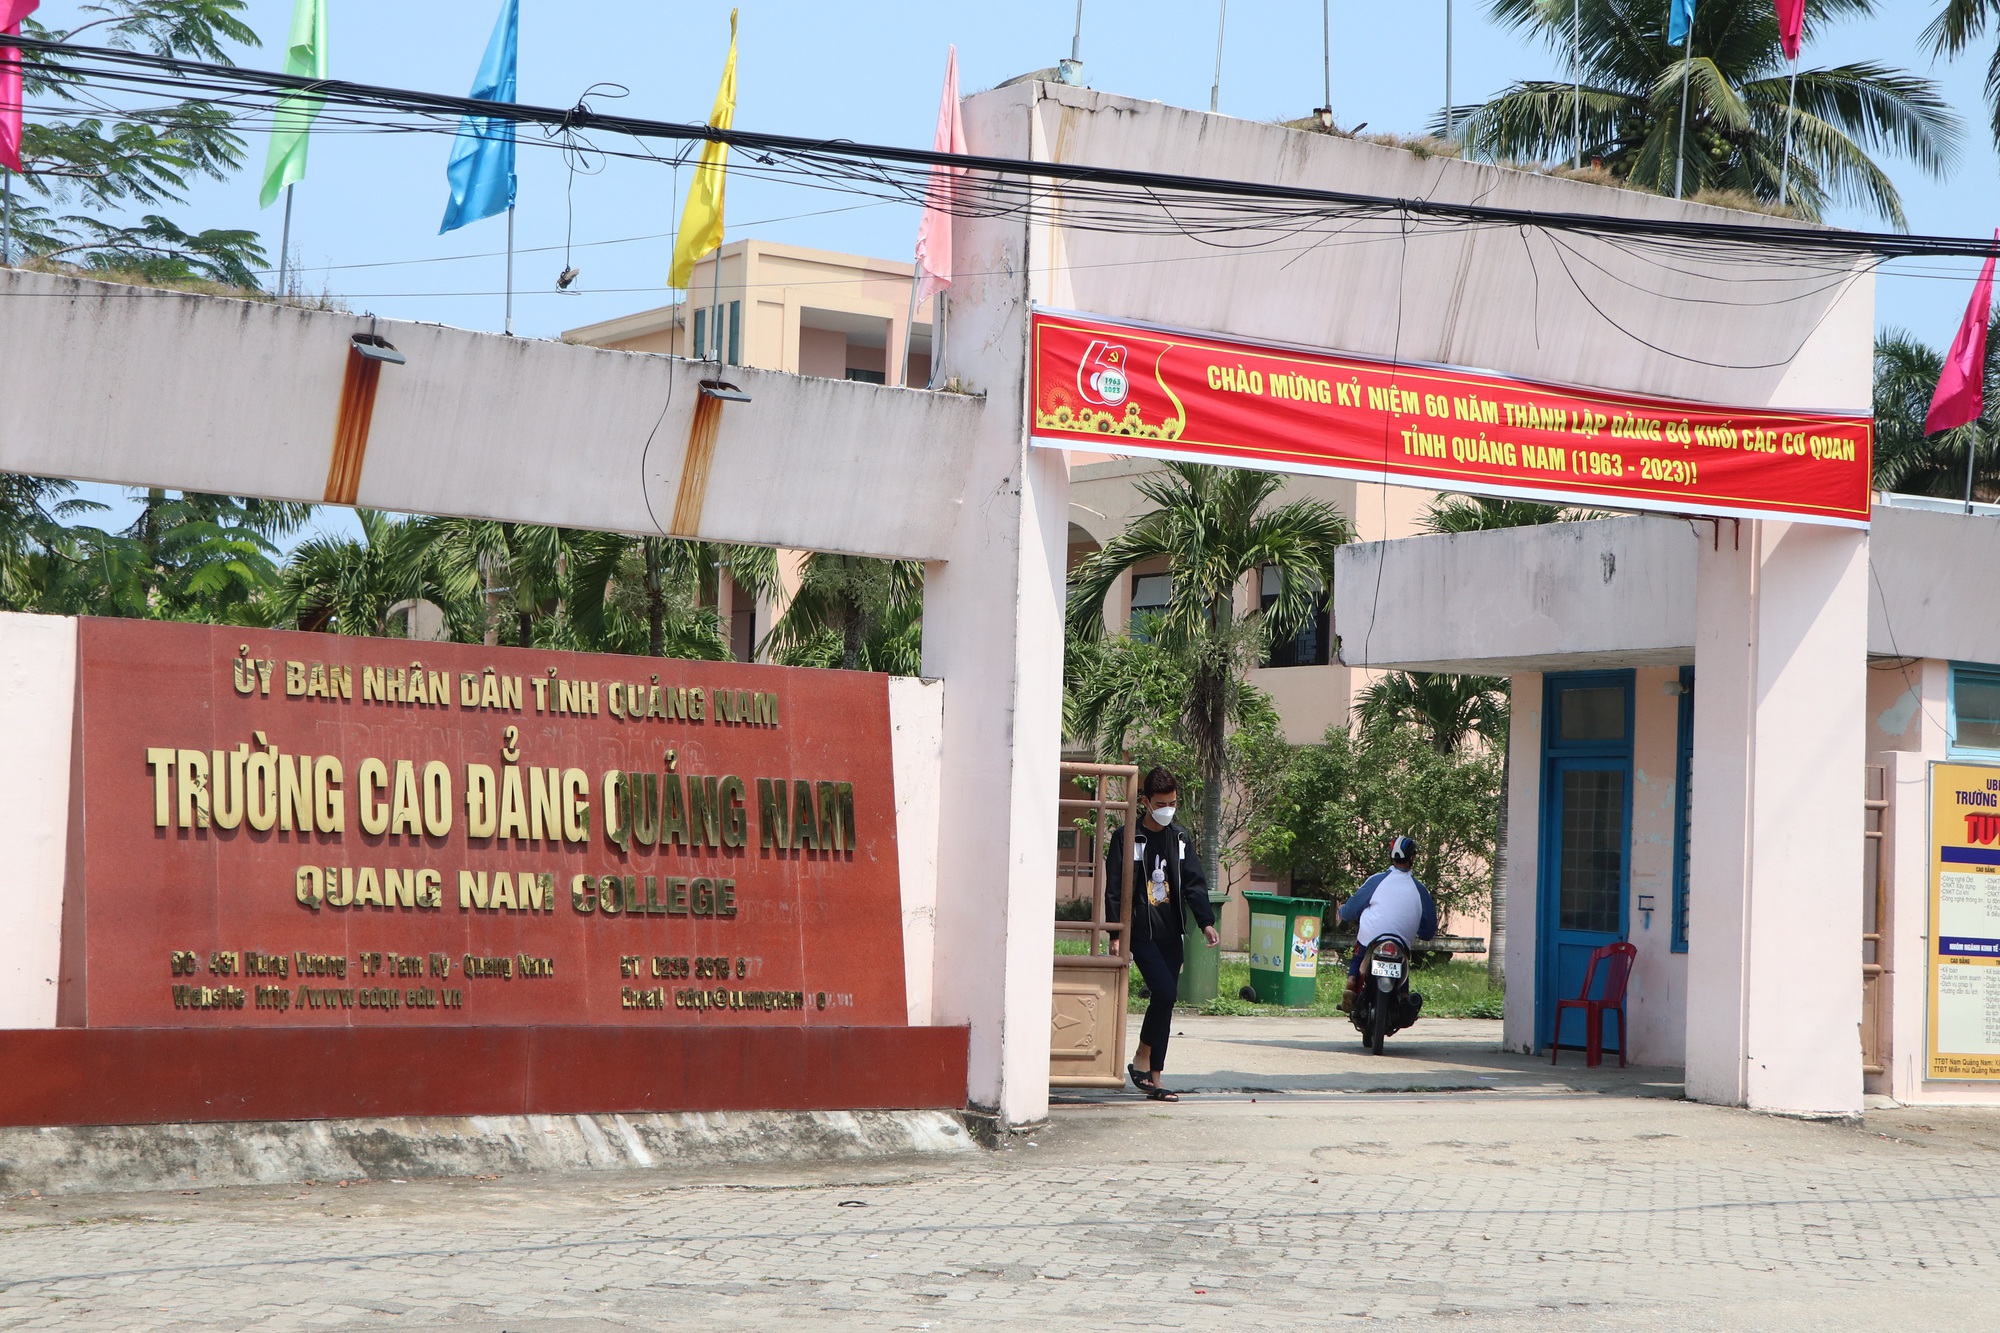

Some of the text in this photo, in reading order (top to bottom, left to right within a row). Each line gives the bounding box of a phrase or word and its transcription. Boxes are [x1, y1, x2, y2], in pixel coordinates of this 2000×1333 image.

[1104, 386, 1121, 394] 2023
[1105, 378, 1121, 386] 1963
[1206, 364, 1856, 462] CHÀO MỪNG KỶ NIỆM 60 NĂM THÀNH LẬP ĐẢNG BỘ KHỐI CÁC CƠ QUAN
[1401, 423, 1447, 460] TỈNH
[1452, 432, 1517, 468] QUẢNG
[1522, 445, 1566, 473] NAM
[1572, 452, 1623, 478] (1963
[1640, 456, 1698, 486] 2023)!
[234, 643, 779, 726] ỦY BAN NHÂN DÂN TỈNH QUẢNG NAM
[147, 725, 856, 853] TRƯỜNG CAO ĐẲNG QUẢNG NAM
[1955, 788, 1998, 808] TRƯỜNG
[295, 865, 738, 916] QUANG NAM COLLEGE
[209, 950, 240, 975] 431
[388, 952, 424, 975] Tam
[518, 952, 554, 976] Nam
